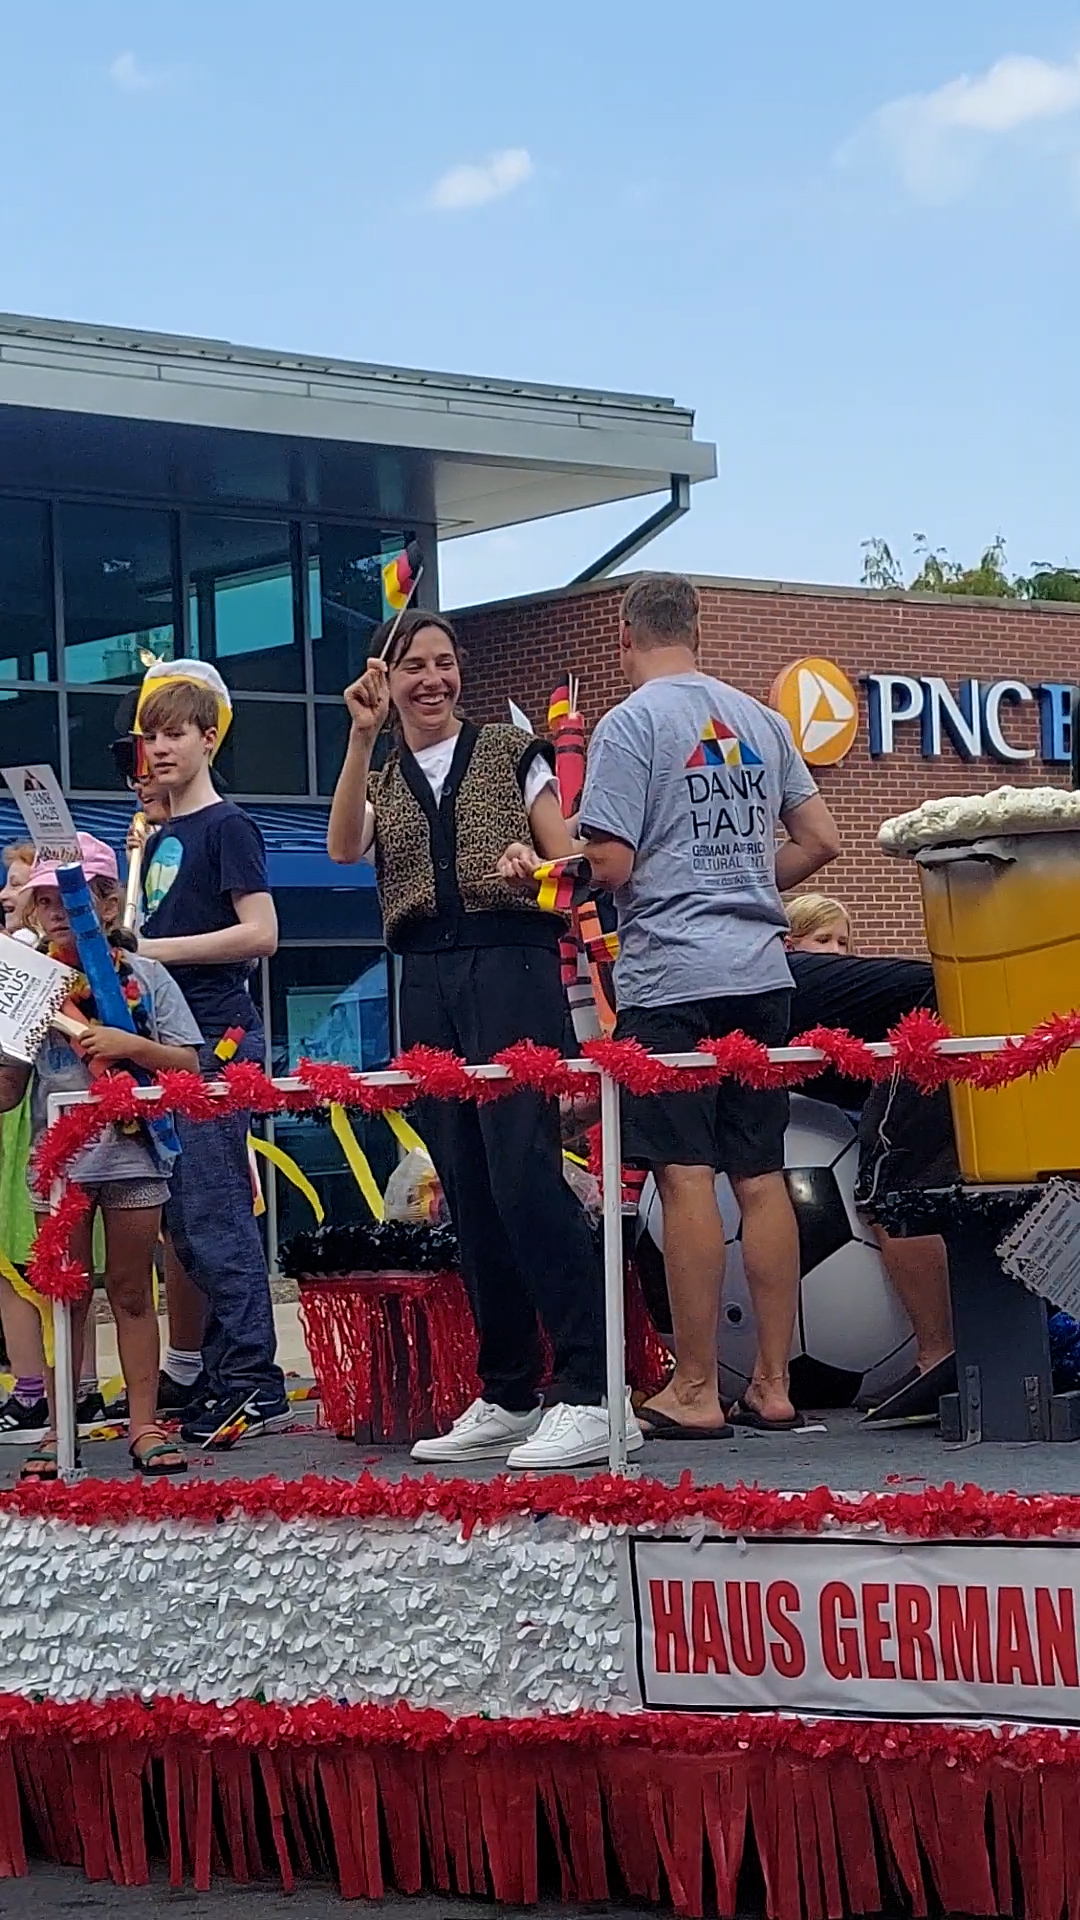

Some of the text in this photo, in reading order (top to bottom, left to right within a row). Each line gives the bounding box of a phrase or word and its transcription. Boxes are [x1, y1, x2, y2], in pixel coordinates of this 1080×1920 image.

[867, 673, 1036, 760] PNC
[685, 770, 766, 804] DANK
[690, 806, 765, 839] HAUS
[0, 970, 29, 1014] HAUS
[649, 1580, 1080, 1688] HAUS GERMAN
